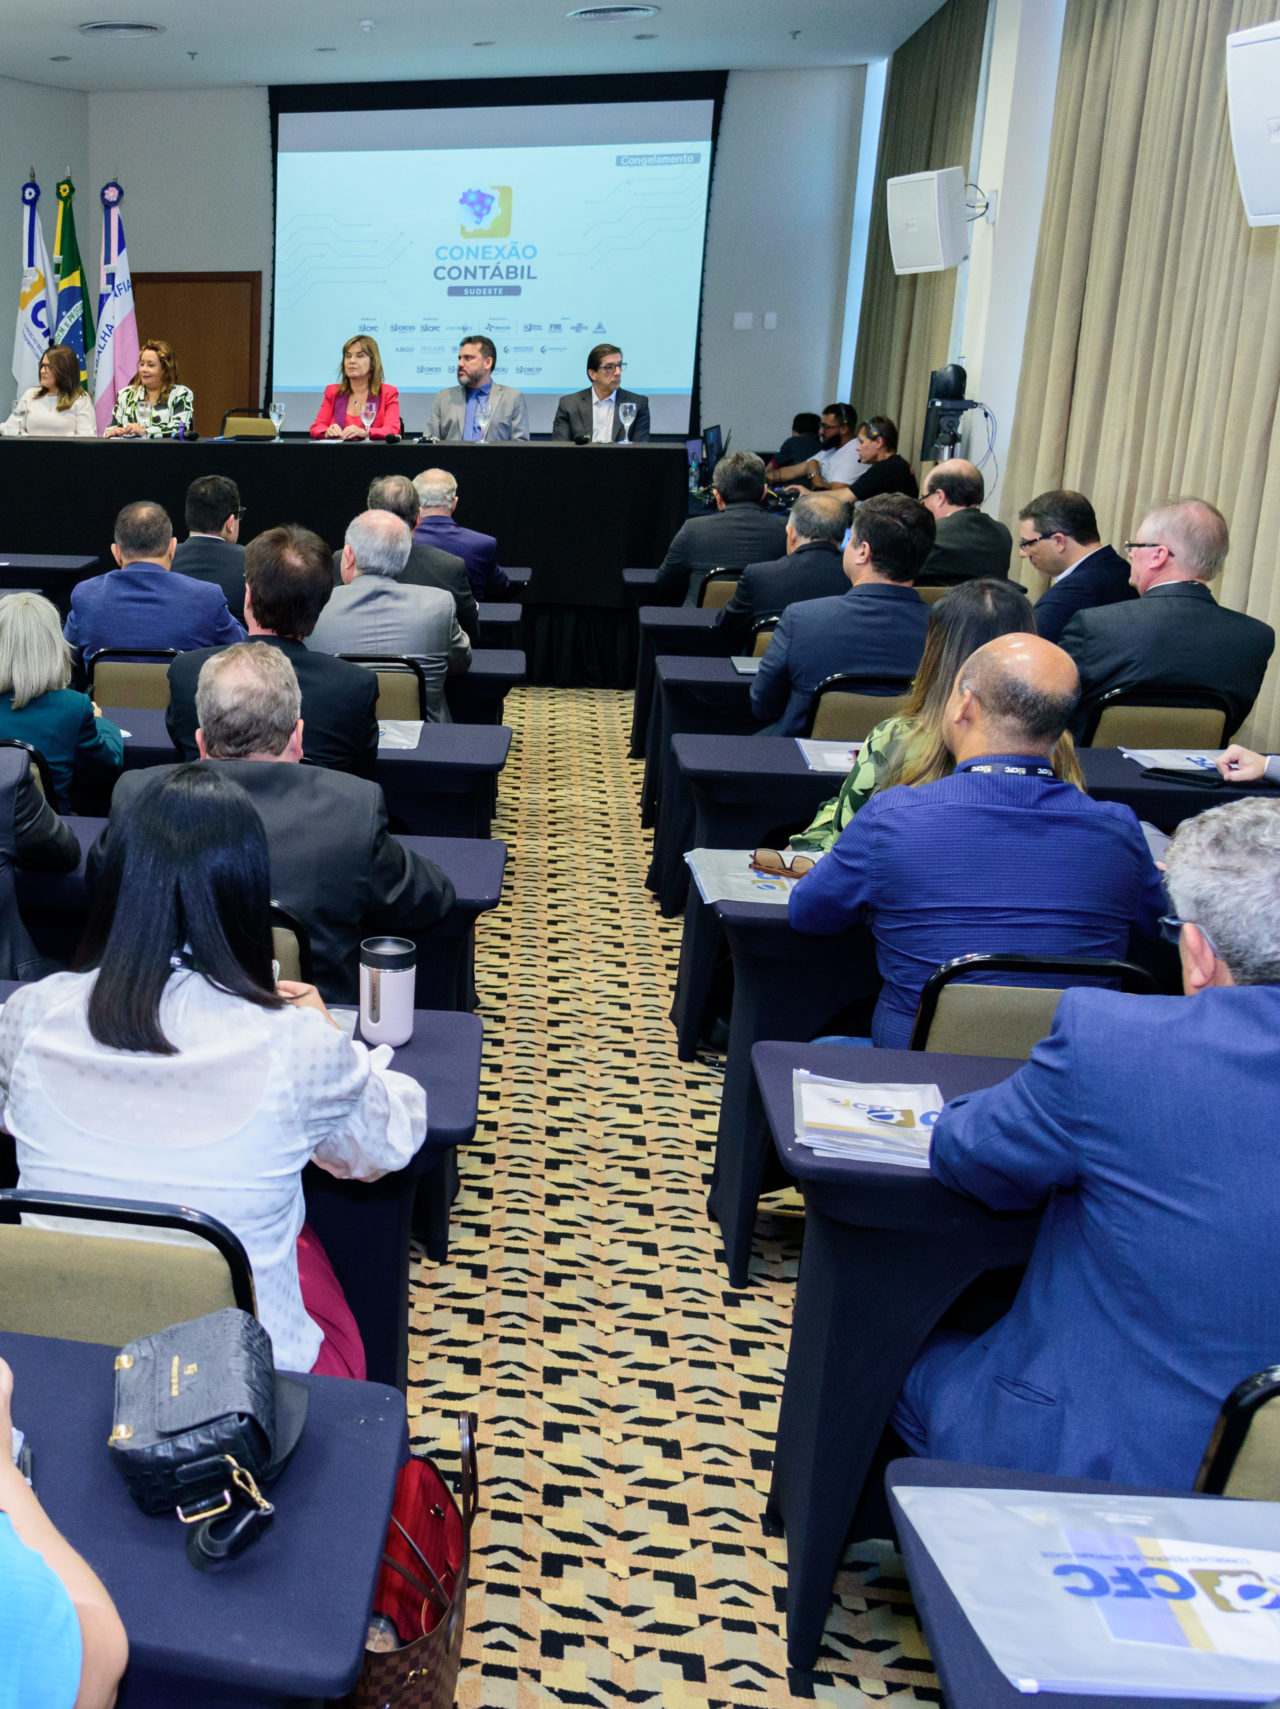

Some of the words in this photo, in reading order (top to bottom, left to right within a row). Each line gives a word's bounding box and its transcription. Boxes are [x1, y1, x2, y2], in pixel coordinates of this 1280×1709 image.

[621, 154, 695, 167] Congelamento
[434, 241, 538, 260] CONEXÃO
[433, 261, 538, 281] CONTÁBIL
[463, 287, 505, 296] SUDESTE
[1052, 1563, 1197, 1601] CFC
